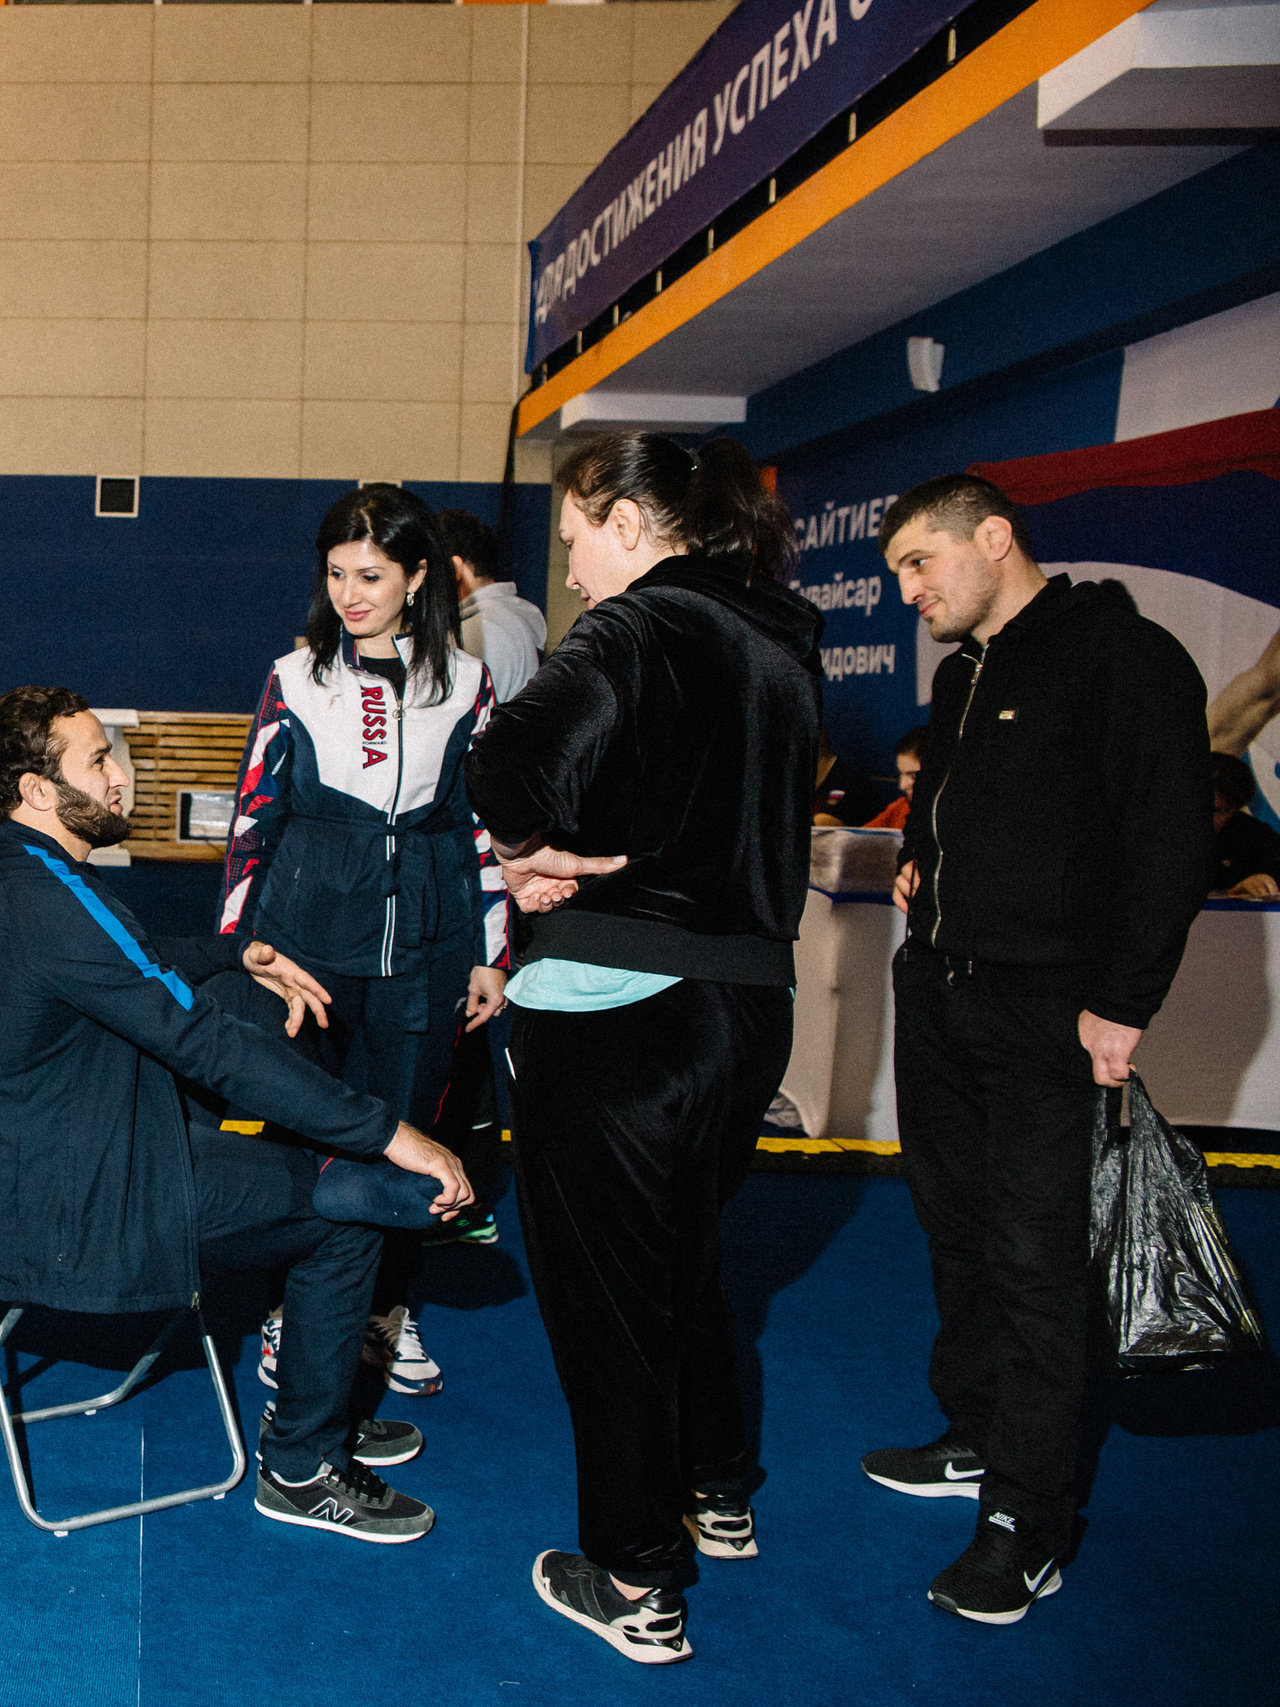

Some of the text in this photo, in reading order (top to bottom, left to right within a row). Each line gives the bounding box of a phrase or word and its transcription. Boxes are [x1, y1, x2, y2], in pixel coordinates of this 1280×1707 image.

[562, 108, 708, 301] ДОСТИЖЕНИЯ
[713, 0, 838, 155] УСПЕХА
[992, 1511, 1016, 1525] NIKE
